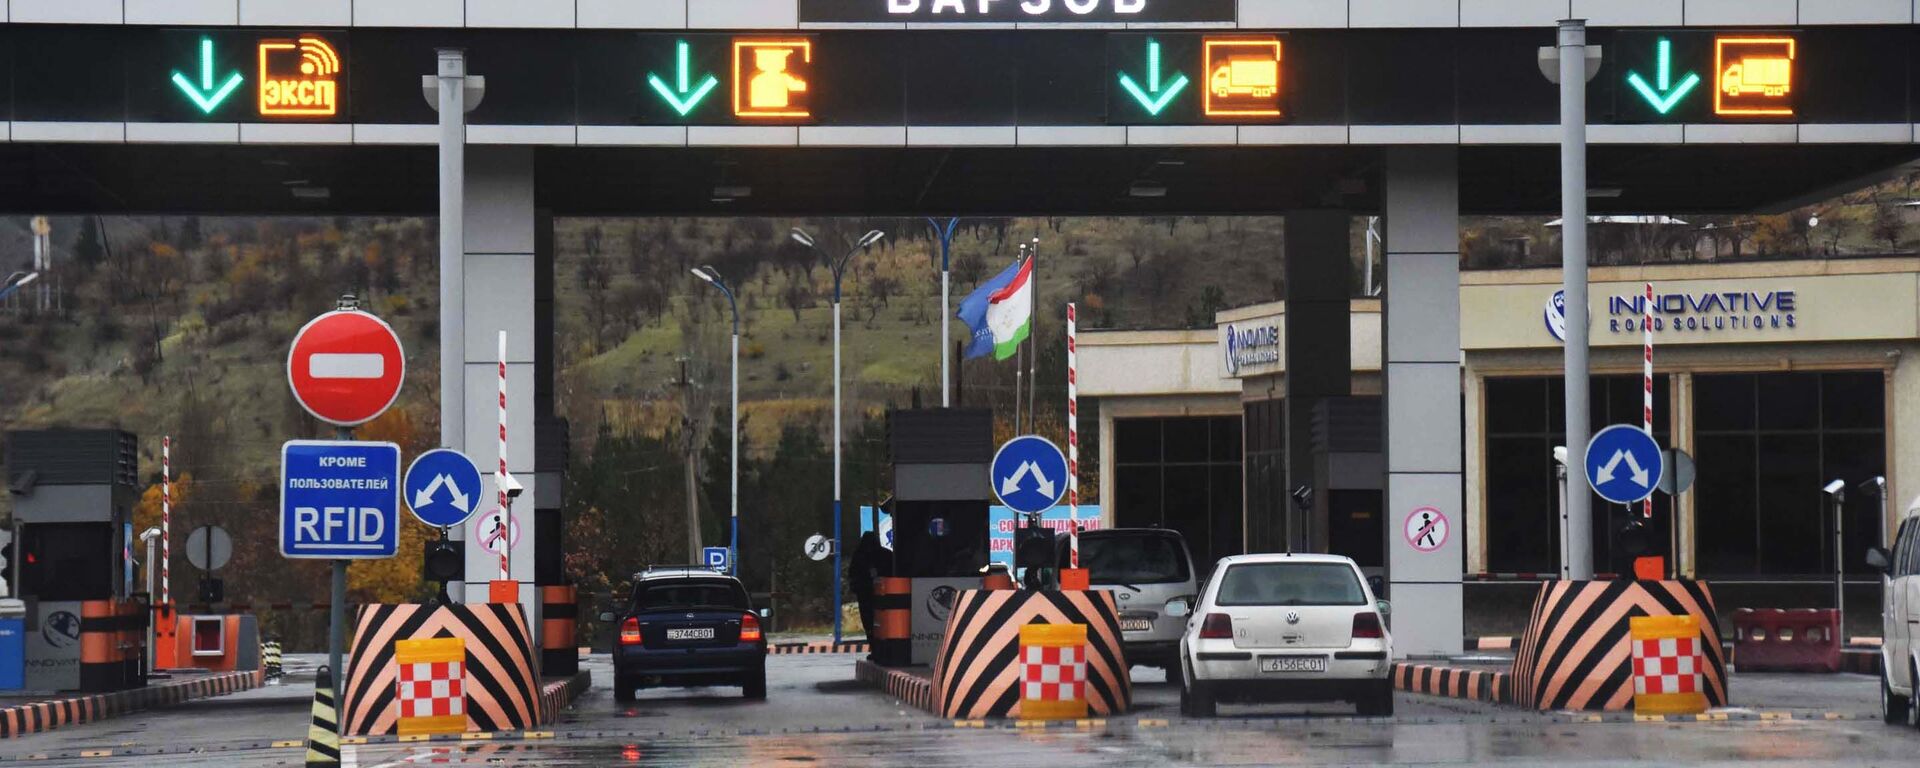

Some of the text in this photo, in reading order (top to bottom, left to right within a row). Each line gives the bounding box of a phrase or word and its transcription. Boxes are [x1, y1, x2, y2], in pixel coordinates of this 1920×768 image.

[265, 80, 335, 106] ЭКСП
[1609, 291, 1795, 314] INNOVATIVE
[1674, 314, 1795, 330] SOLUTIONS
[319, 456, 367, 467] КРОМЕ
[289, 477, 388, 489] ПОЛЬЗОВАТЕЛЕЙ
[294, 507, 385, 542] RFID
[1272, 658, 1322, 670] 6156EC01
